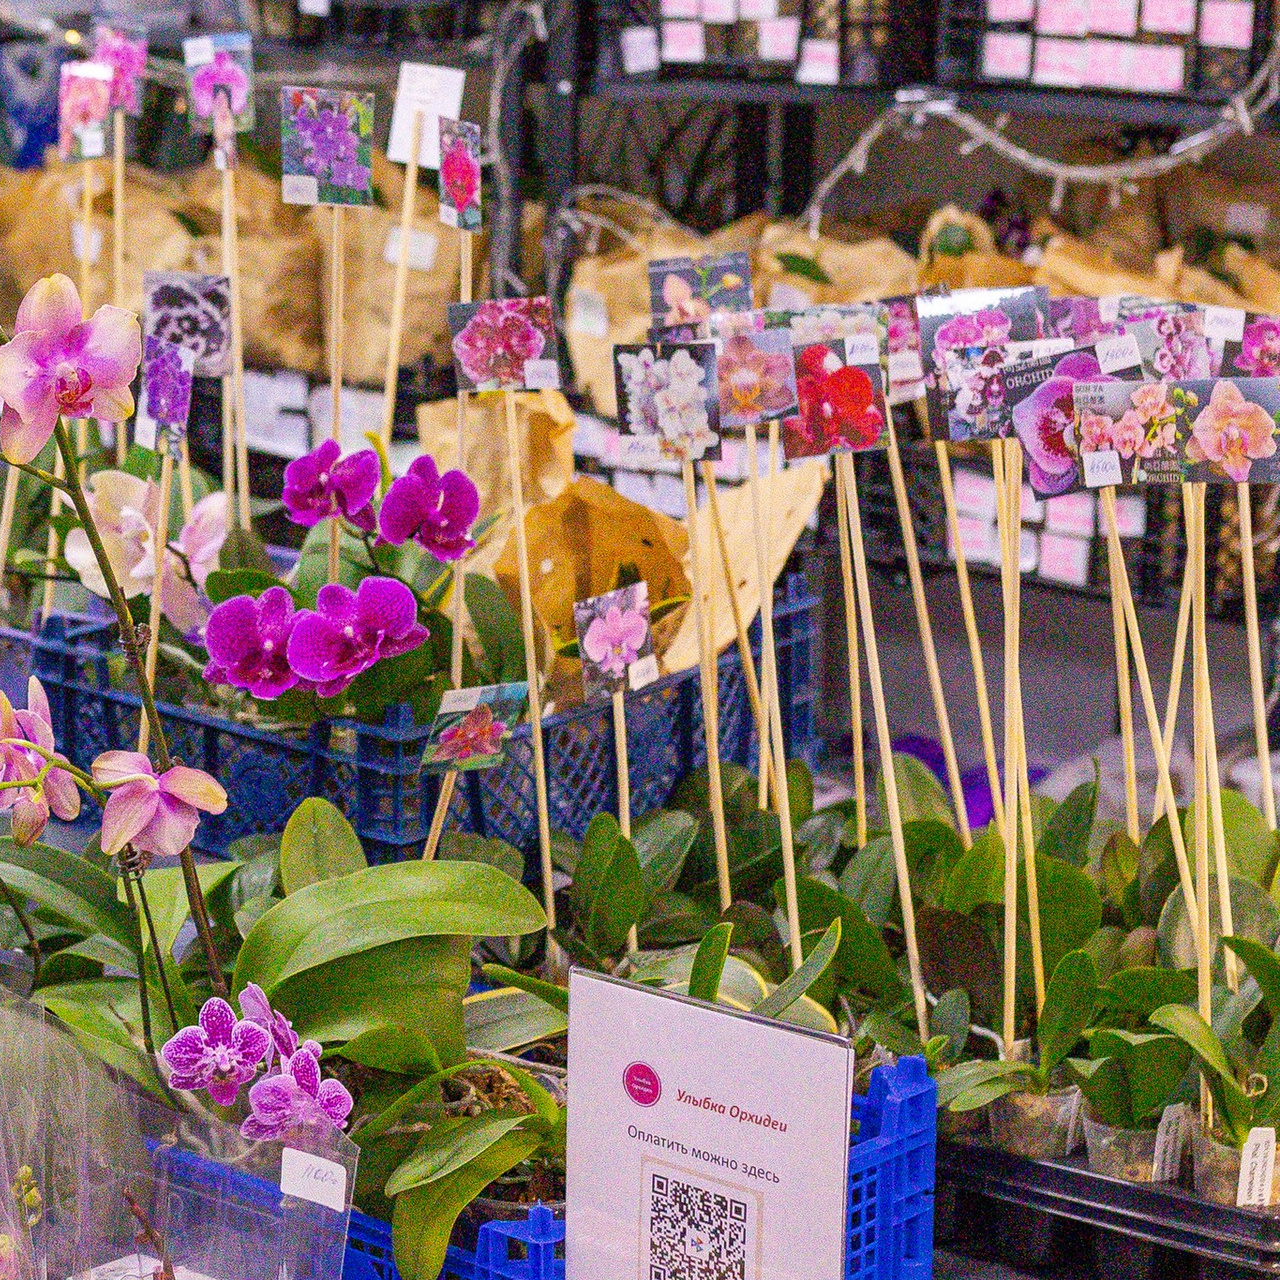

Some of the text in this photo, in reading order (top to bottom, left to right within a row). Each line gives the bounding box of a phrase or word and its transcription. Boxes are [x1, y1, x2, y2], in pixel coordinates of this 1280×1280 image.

[676, 1088, 788, 1133] Улыбка Орхидеи
[627, 1124, 781, 1184] Оплатить можно здесь
